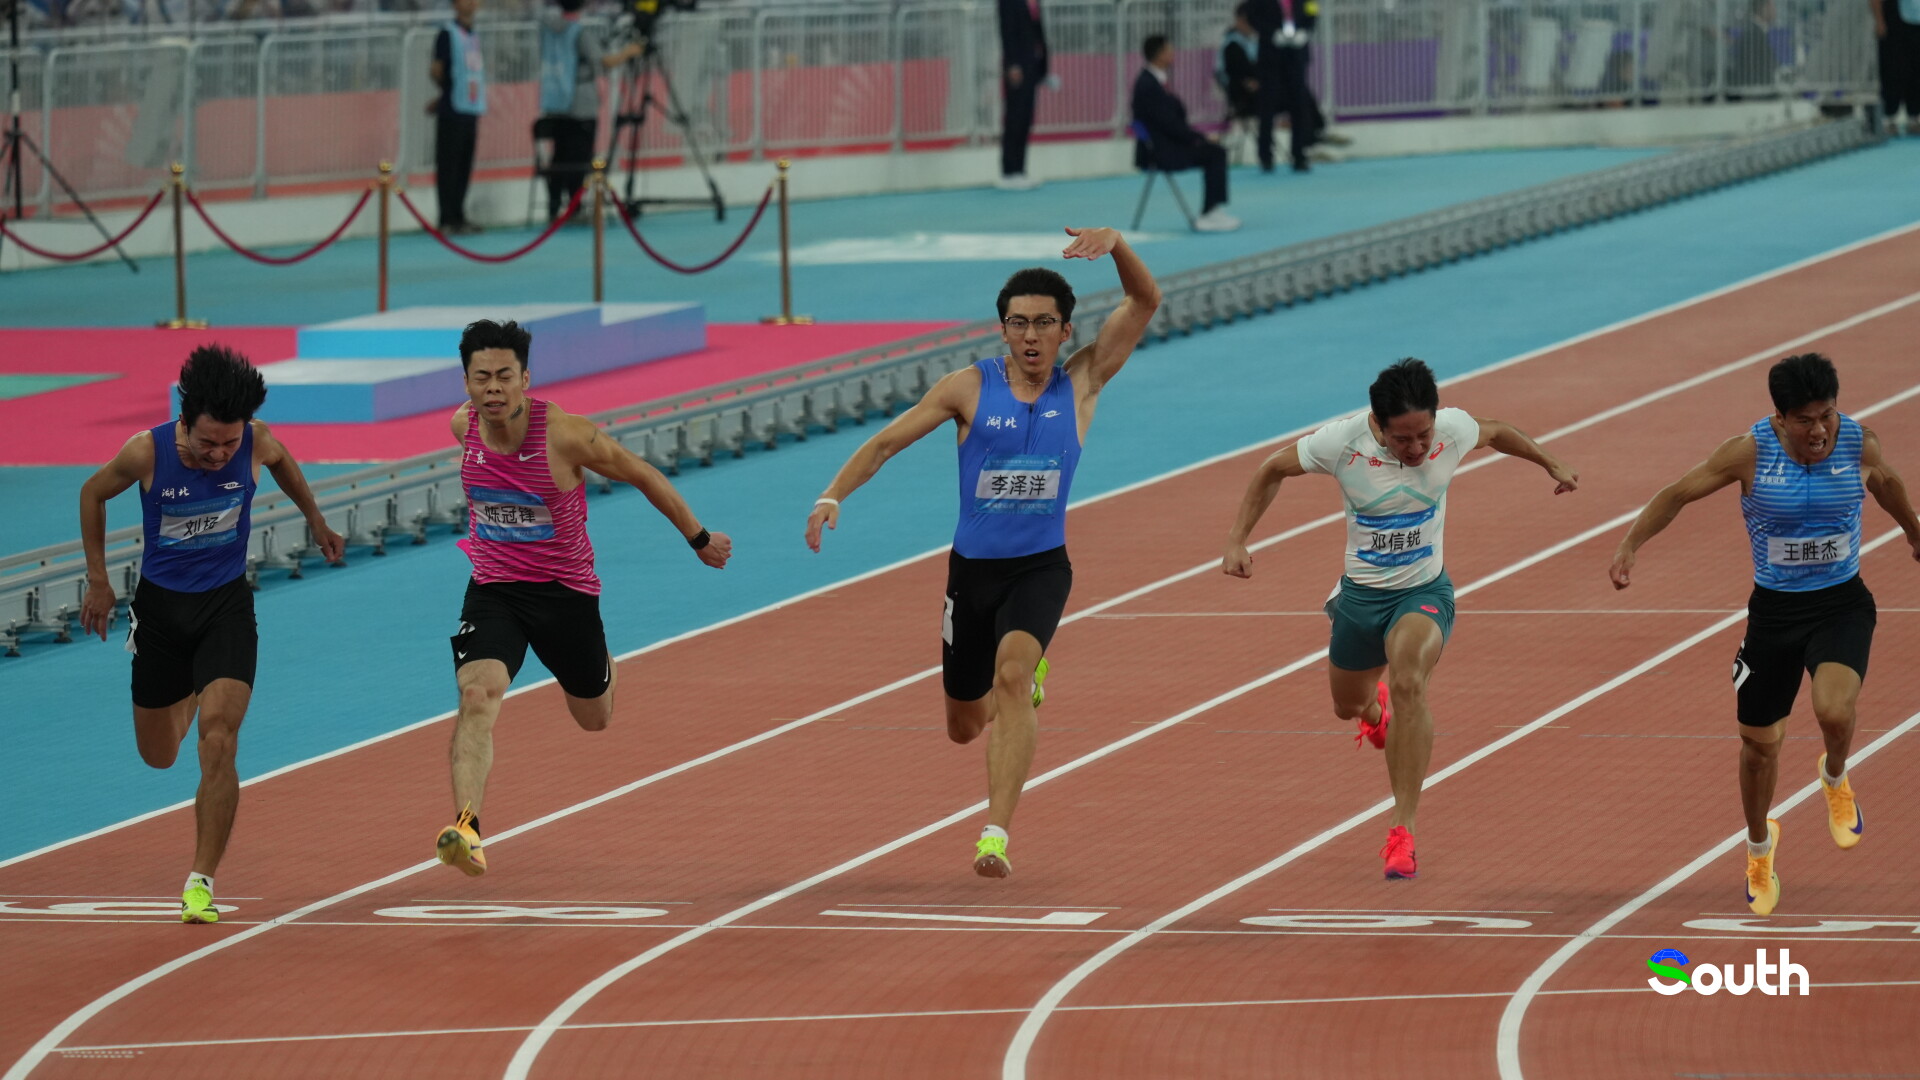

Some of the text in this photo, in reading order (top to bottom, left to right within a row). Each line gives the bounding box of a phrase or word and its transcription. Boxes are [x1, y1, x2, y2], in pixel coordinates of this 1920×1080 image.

[986, 416, 1018, 430] 湖北
[465, 449, 486, 464] 广东
[1347, 450, 1382, 467] 广西
[161, 486, 190, 499] 湖北
[991, 475, 1046, 496] 李泽洋
[484, 505, 536, 524] 陈冠锋
[1371, 528, 1422, 551] 邓信锐
[1783, 539, 1838, 562] 王胜杰
[373, 905, 669, 919] 8
[818, 909, 1109, 925] 7
